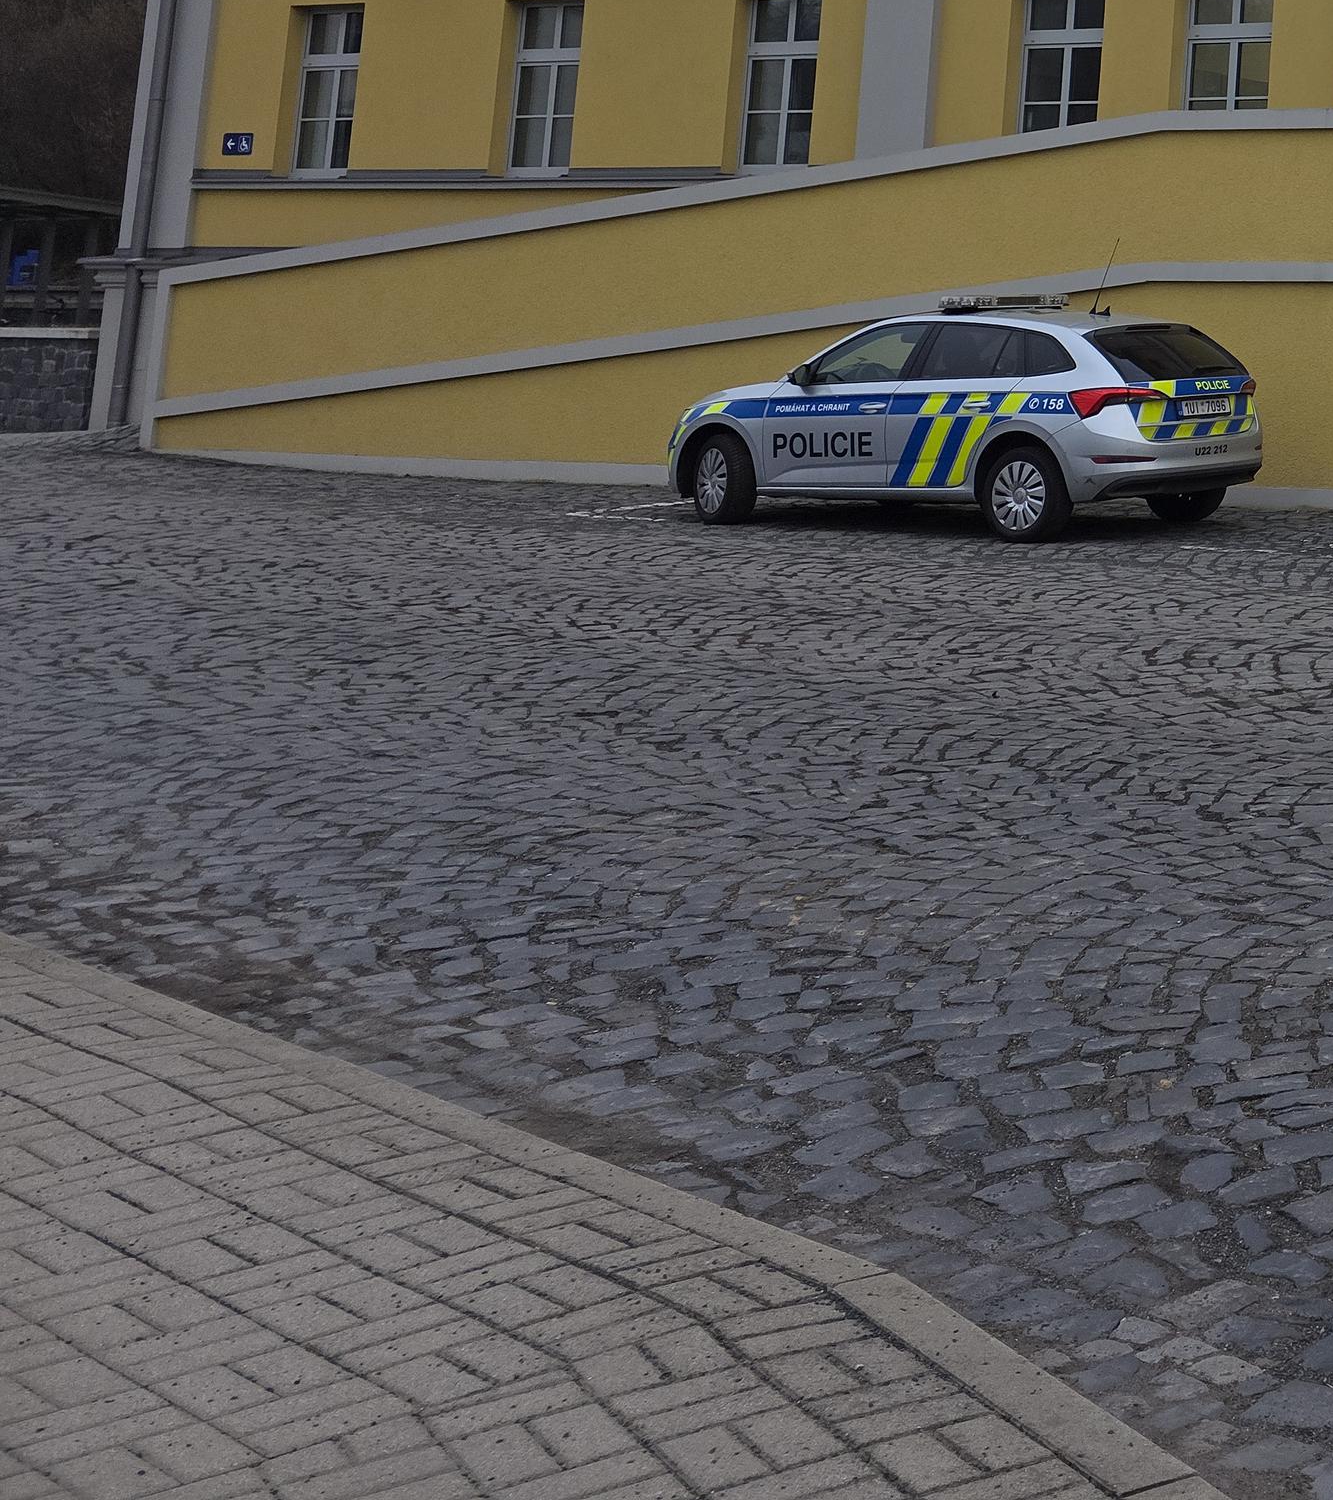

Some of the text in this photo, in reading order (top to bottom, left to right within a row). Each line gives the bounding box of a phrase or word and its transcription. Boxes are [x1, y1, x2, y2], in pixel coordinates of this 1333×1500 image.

[1195, 380, 1231, 390] POLICIE
[775, 403, 810, 413] POMÁHAT
[810, 404, 816, 412] A
[1042, 398, 1065, 410] 158
[1205, 400, 1226, 412] 7096
[773, 431, 873, 458] POLICIE
[1194, 444, 1228, 456] U22 212
